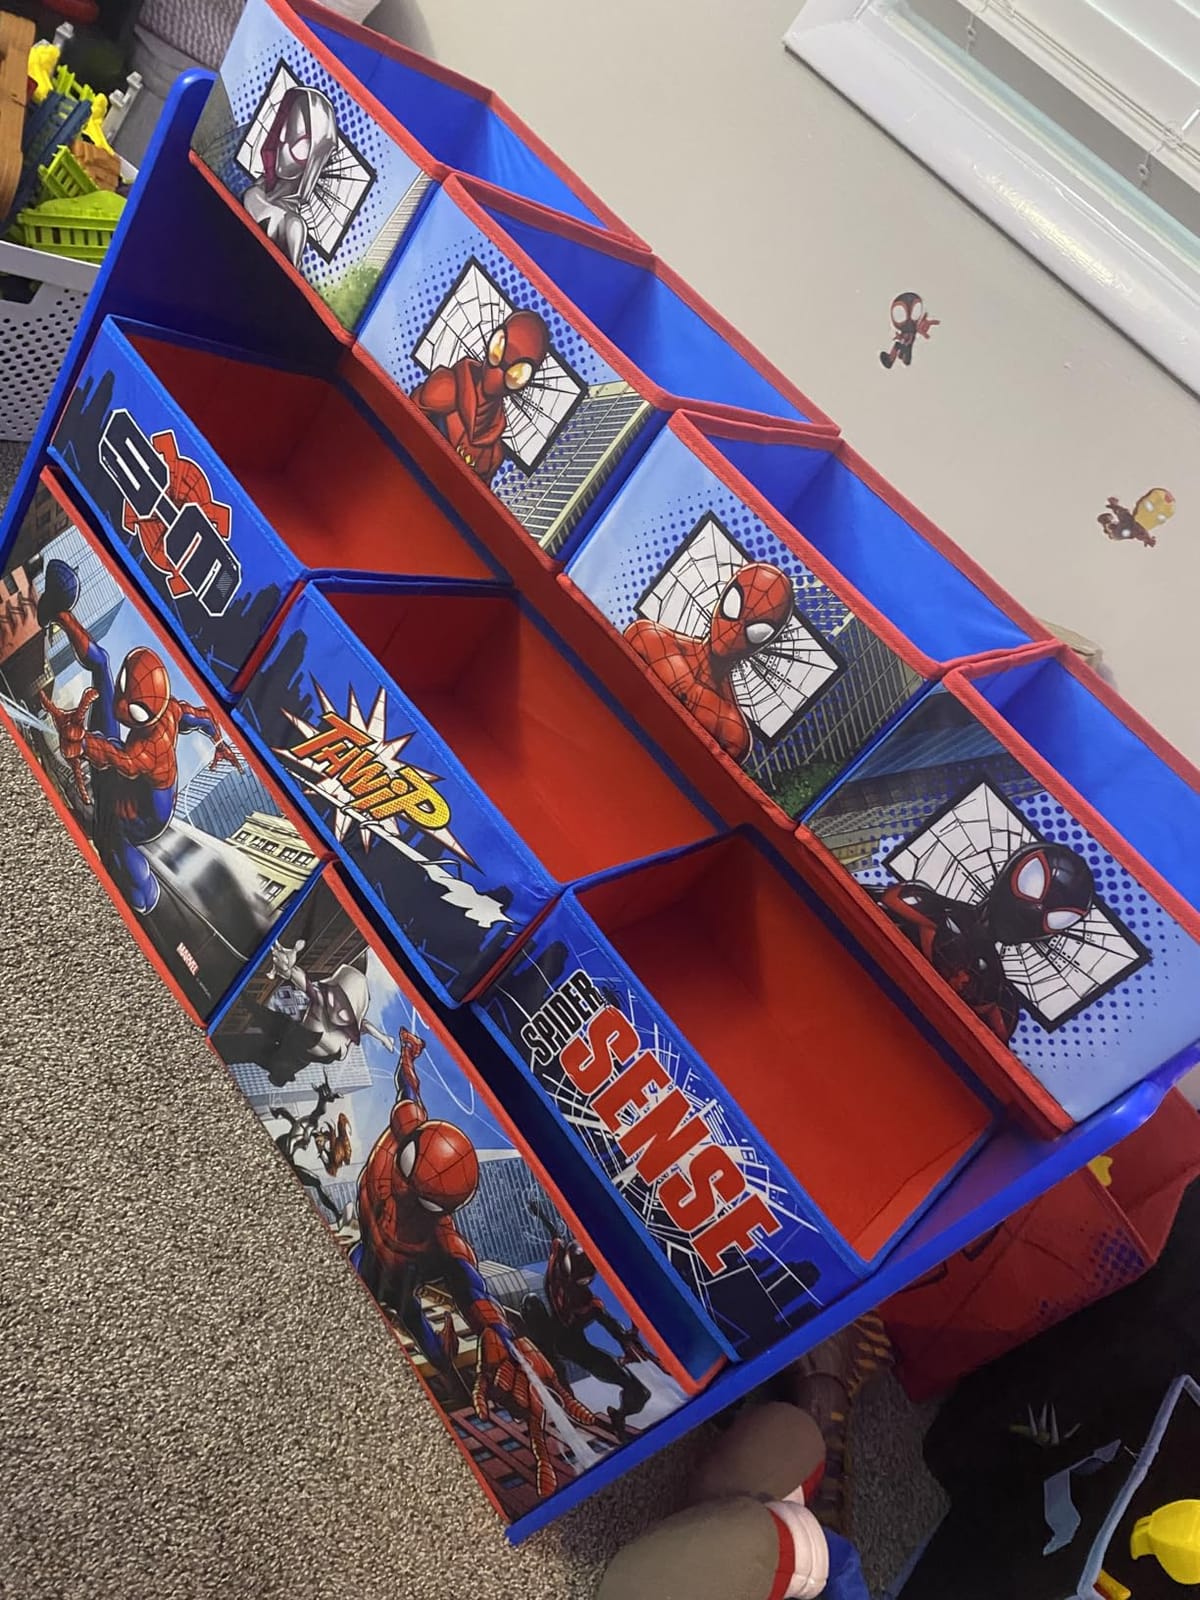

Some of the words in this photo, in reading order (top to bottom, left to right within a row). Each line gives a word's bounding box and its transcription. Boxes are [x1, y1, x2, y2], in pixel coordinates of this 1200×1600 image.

[176, 941, 199, 976] MARVEL
[521, 970, 604, 1066] SPIDER
[559, 1004, 783, 1277] SENSE
